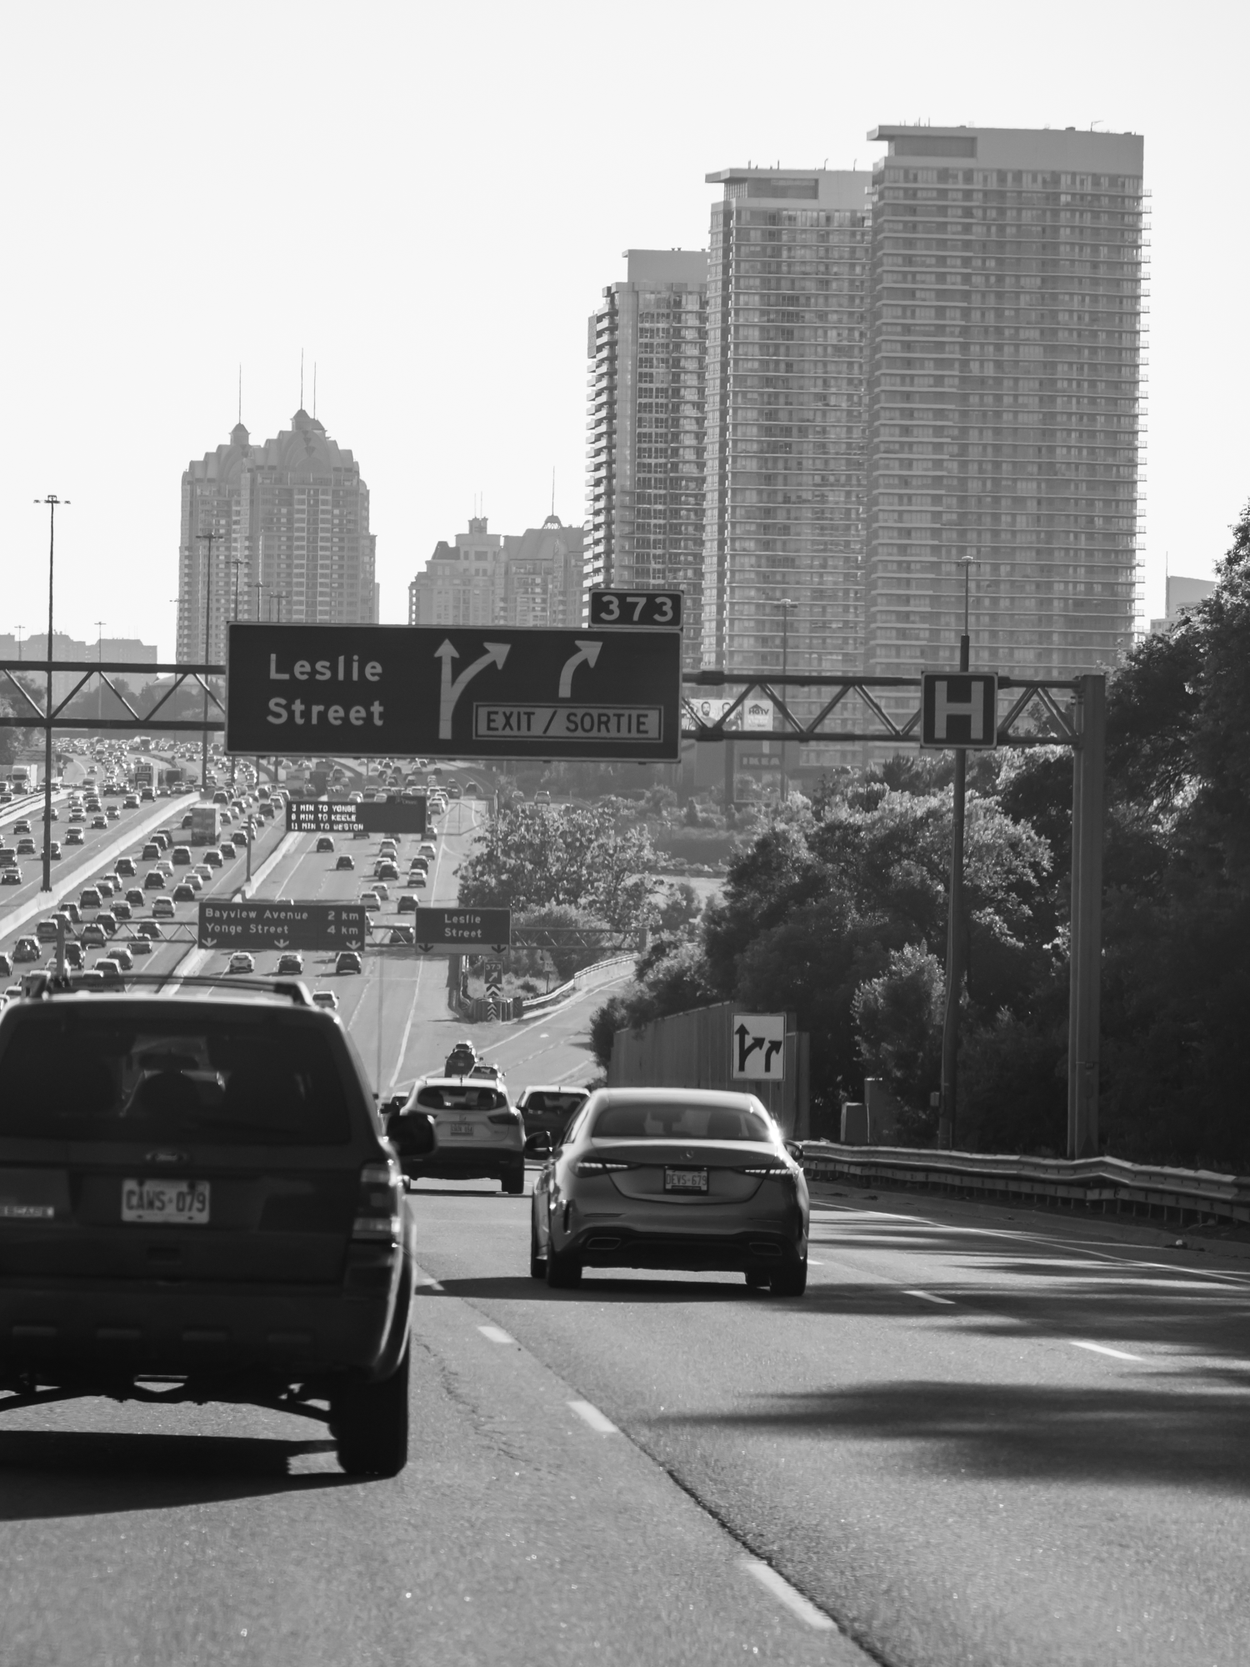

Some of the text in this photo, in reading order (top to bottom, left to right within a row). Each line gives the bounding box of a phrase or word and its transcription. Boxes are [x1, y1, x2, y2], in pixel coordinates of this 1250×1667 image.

[599, 595, 674, 623] 373
[269, 653, 383, 682] Leslie
[266, 697, 385, 727] Street
[934, 680, 984, 740] H
[486, 710, 536, 732] EXIT
[565, 711, 649, 735] SORTIE
[742, 757, 781, 766] IKEA
[291, 804, 357, 813] 3 MIN TO YONGE
[300, 813, 315, 821] MIN
[318, 813, 329, 821] TO
[301, 822, 316, 830] MIN
[319, 823, 330, 831] TO
[205, 908, 359, 921] Bayview Avenue 2 km
[444, 913, 482, 924] Leslie
[206, 923, 359, 935] Yonge Street 4 km
[444, 927, 482, 938] Street
